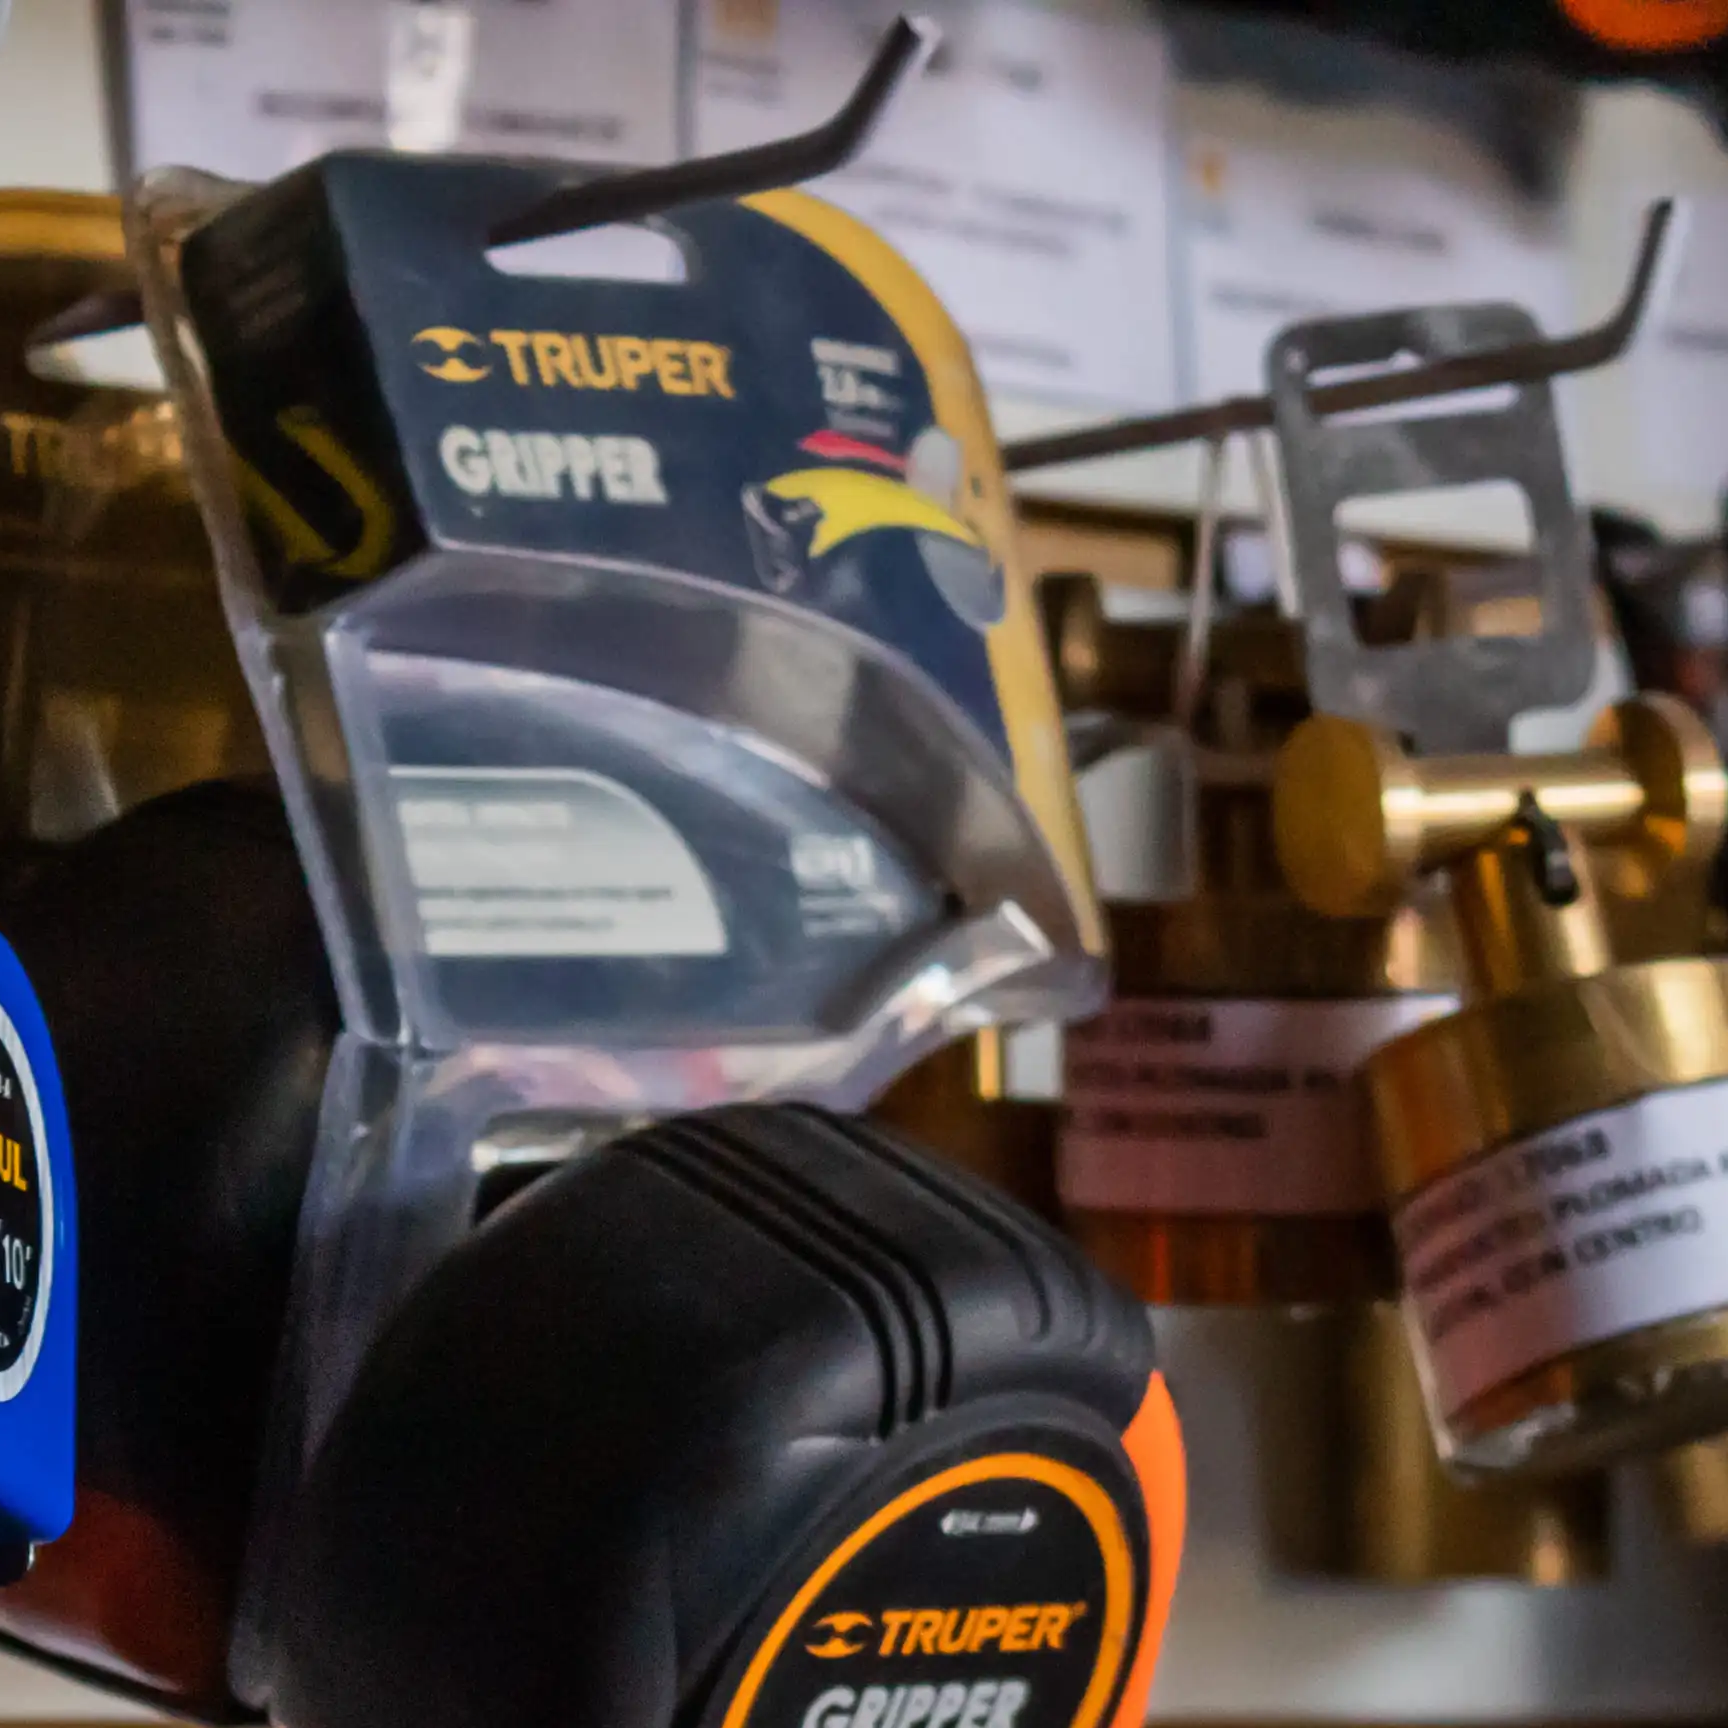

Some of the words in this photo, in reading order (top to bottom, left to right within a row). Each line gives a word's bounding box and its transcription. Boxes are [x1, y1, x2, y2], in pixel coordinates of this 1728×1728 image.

[489, 330, 735, 398] TRUPER
[439, 424, 668, 504] GRIPPER
[878, 1602, 1073, 1657] TRUPER
